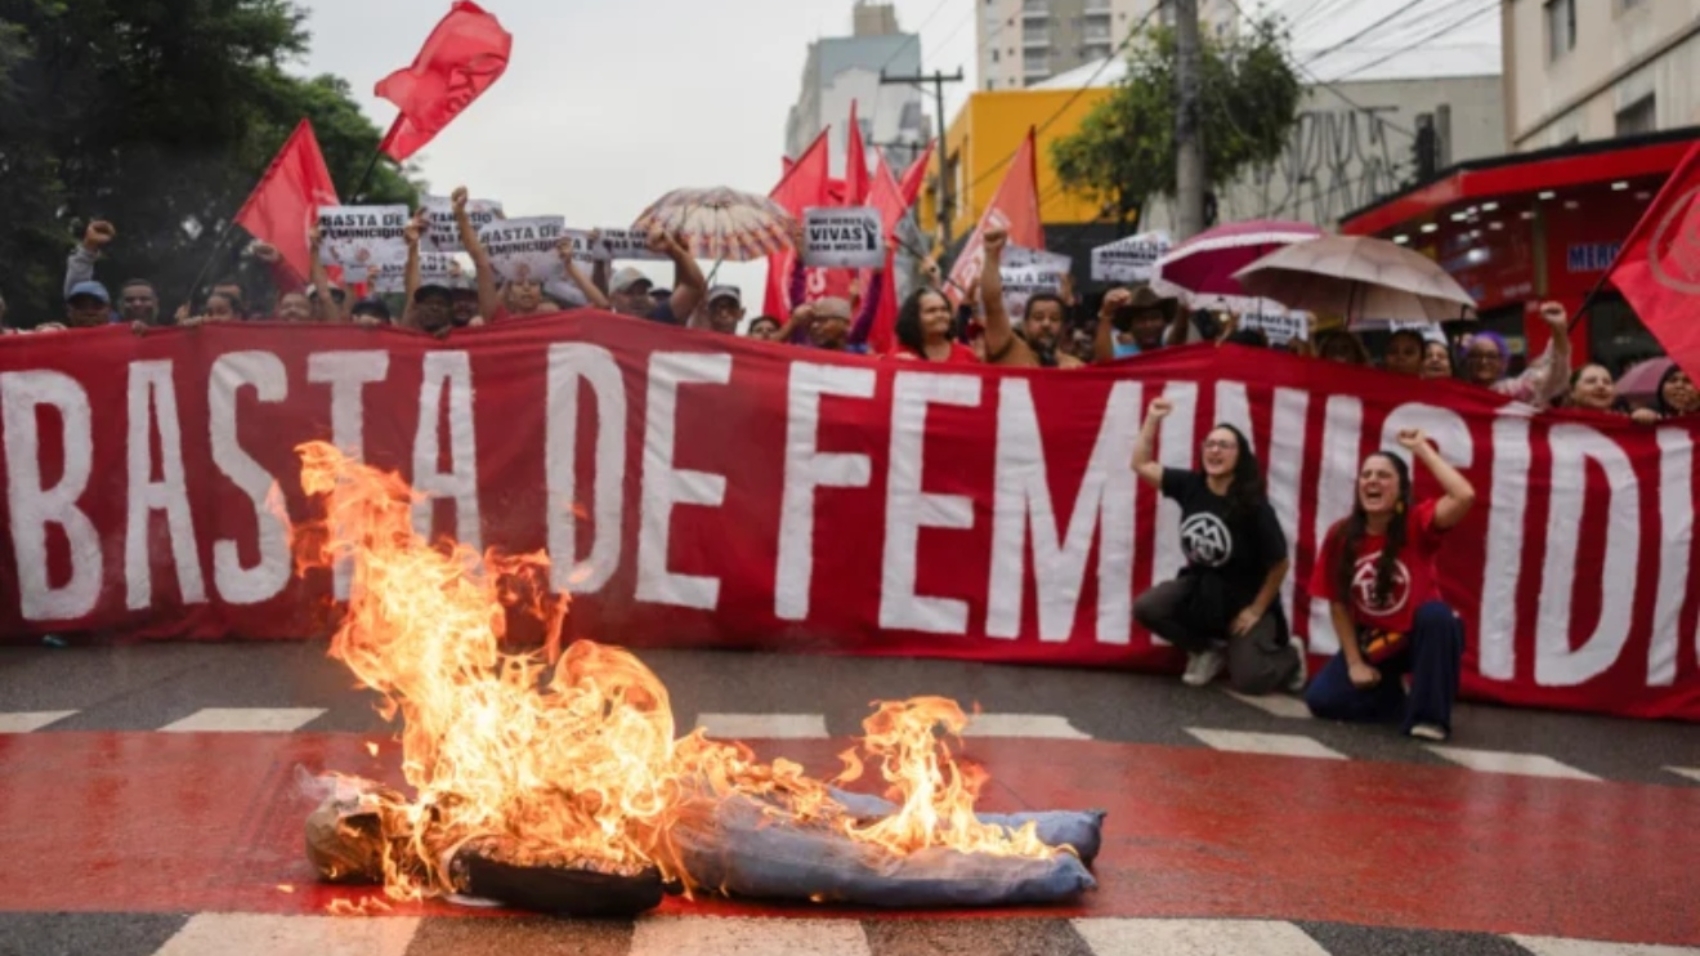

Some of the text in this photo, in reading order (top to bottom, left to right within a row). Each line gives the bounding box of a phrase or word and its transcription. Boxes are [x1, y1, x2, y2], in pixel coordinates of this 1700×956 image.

[383, 213, 405, 226] DE
[810, 227, 862, 241] VIVAS
[0, 350, 483, 621] BASTA
[544, 342, 733, 611] DE
